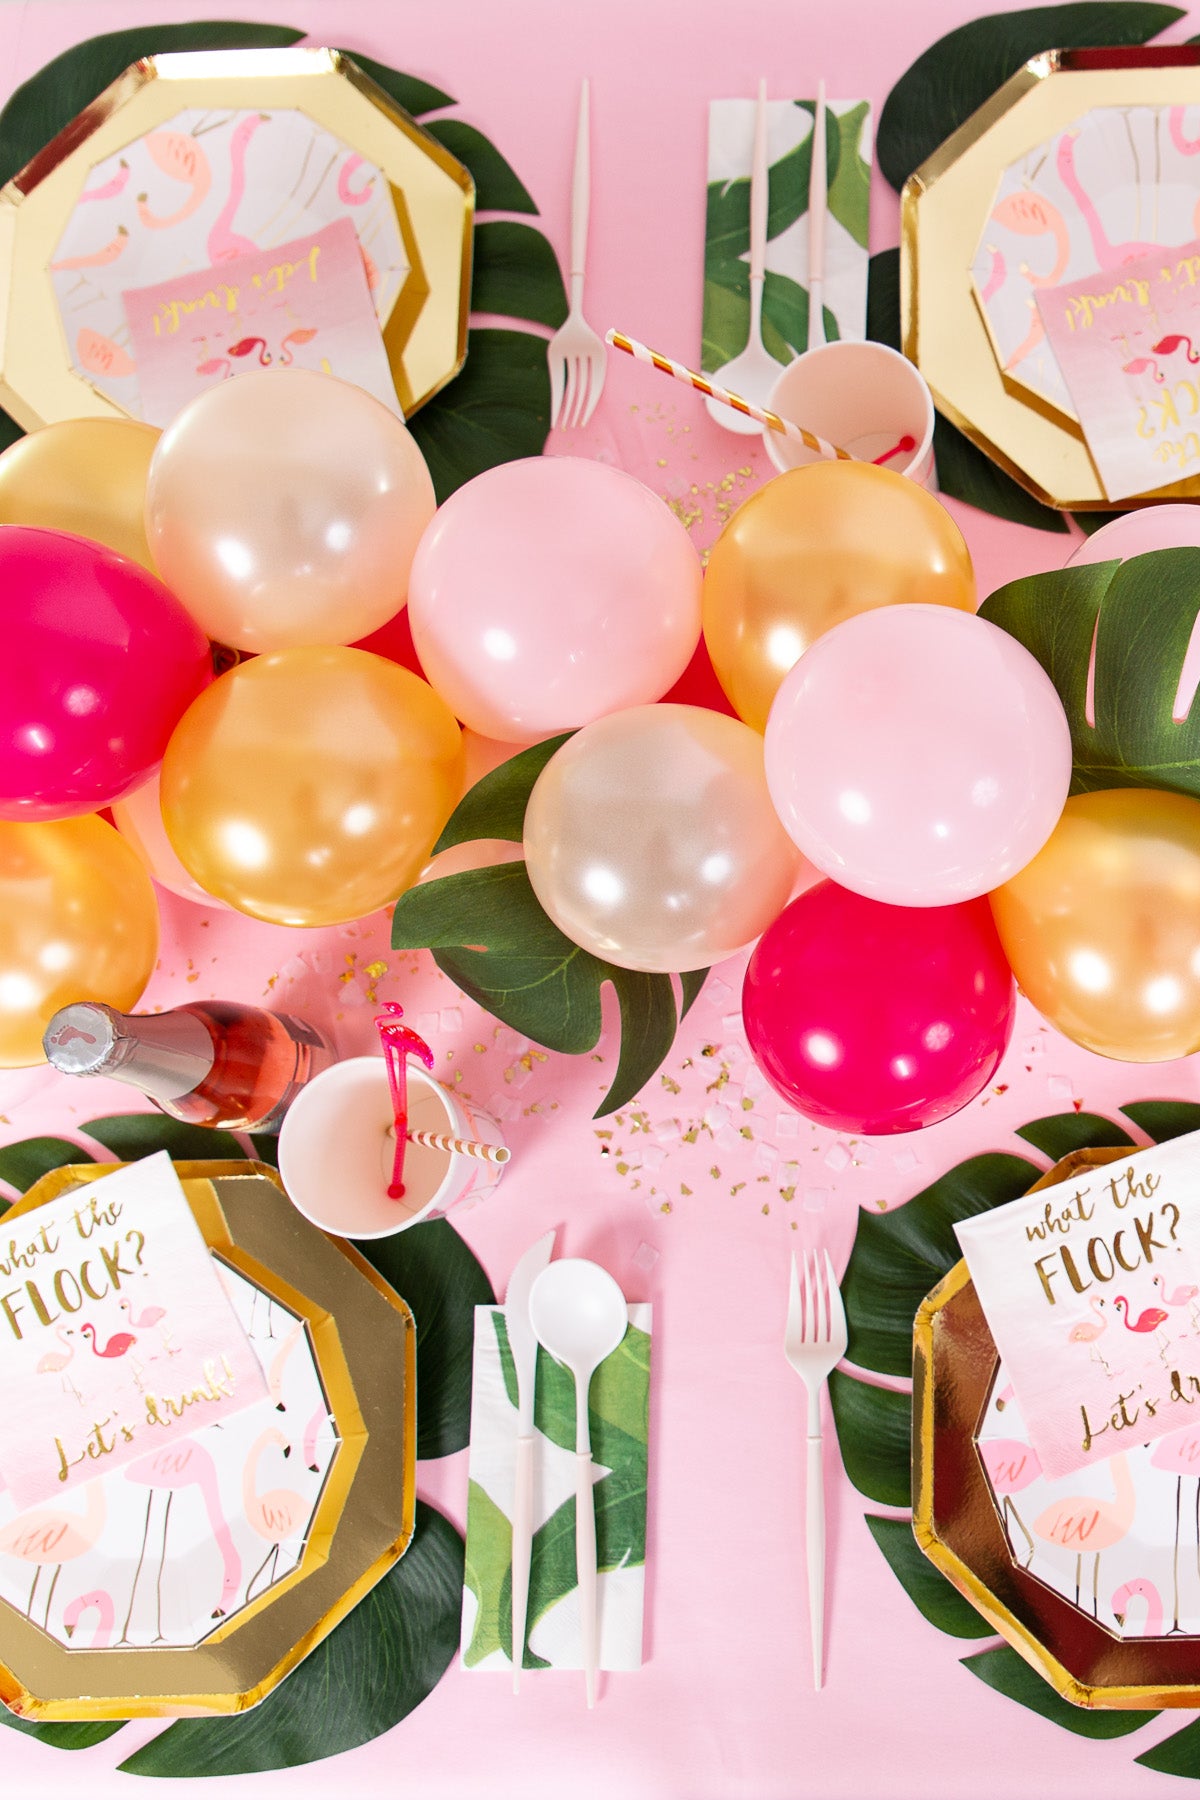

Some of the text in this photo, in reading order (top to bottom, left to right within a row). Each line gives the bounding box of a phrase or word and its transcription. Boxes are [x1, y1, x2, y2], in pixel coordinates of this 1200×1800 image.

[152, 245, 321, 337] Let's drink!
[1064, 277, 1151, 331] drink!
[67, 1197, 123, 1239] the
[1025, 1166, 1161, 1242] what the
[0, 1230, 149, 1340] FLOCK?
[1034, 1203, 1184, 1306] FLOCK?
[55, 1354, 237, 1482] Let's drink!
[1080, 1383, 1161, 1451] Let's
